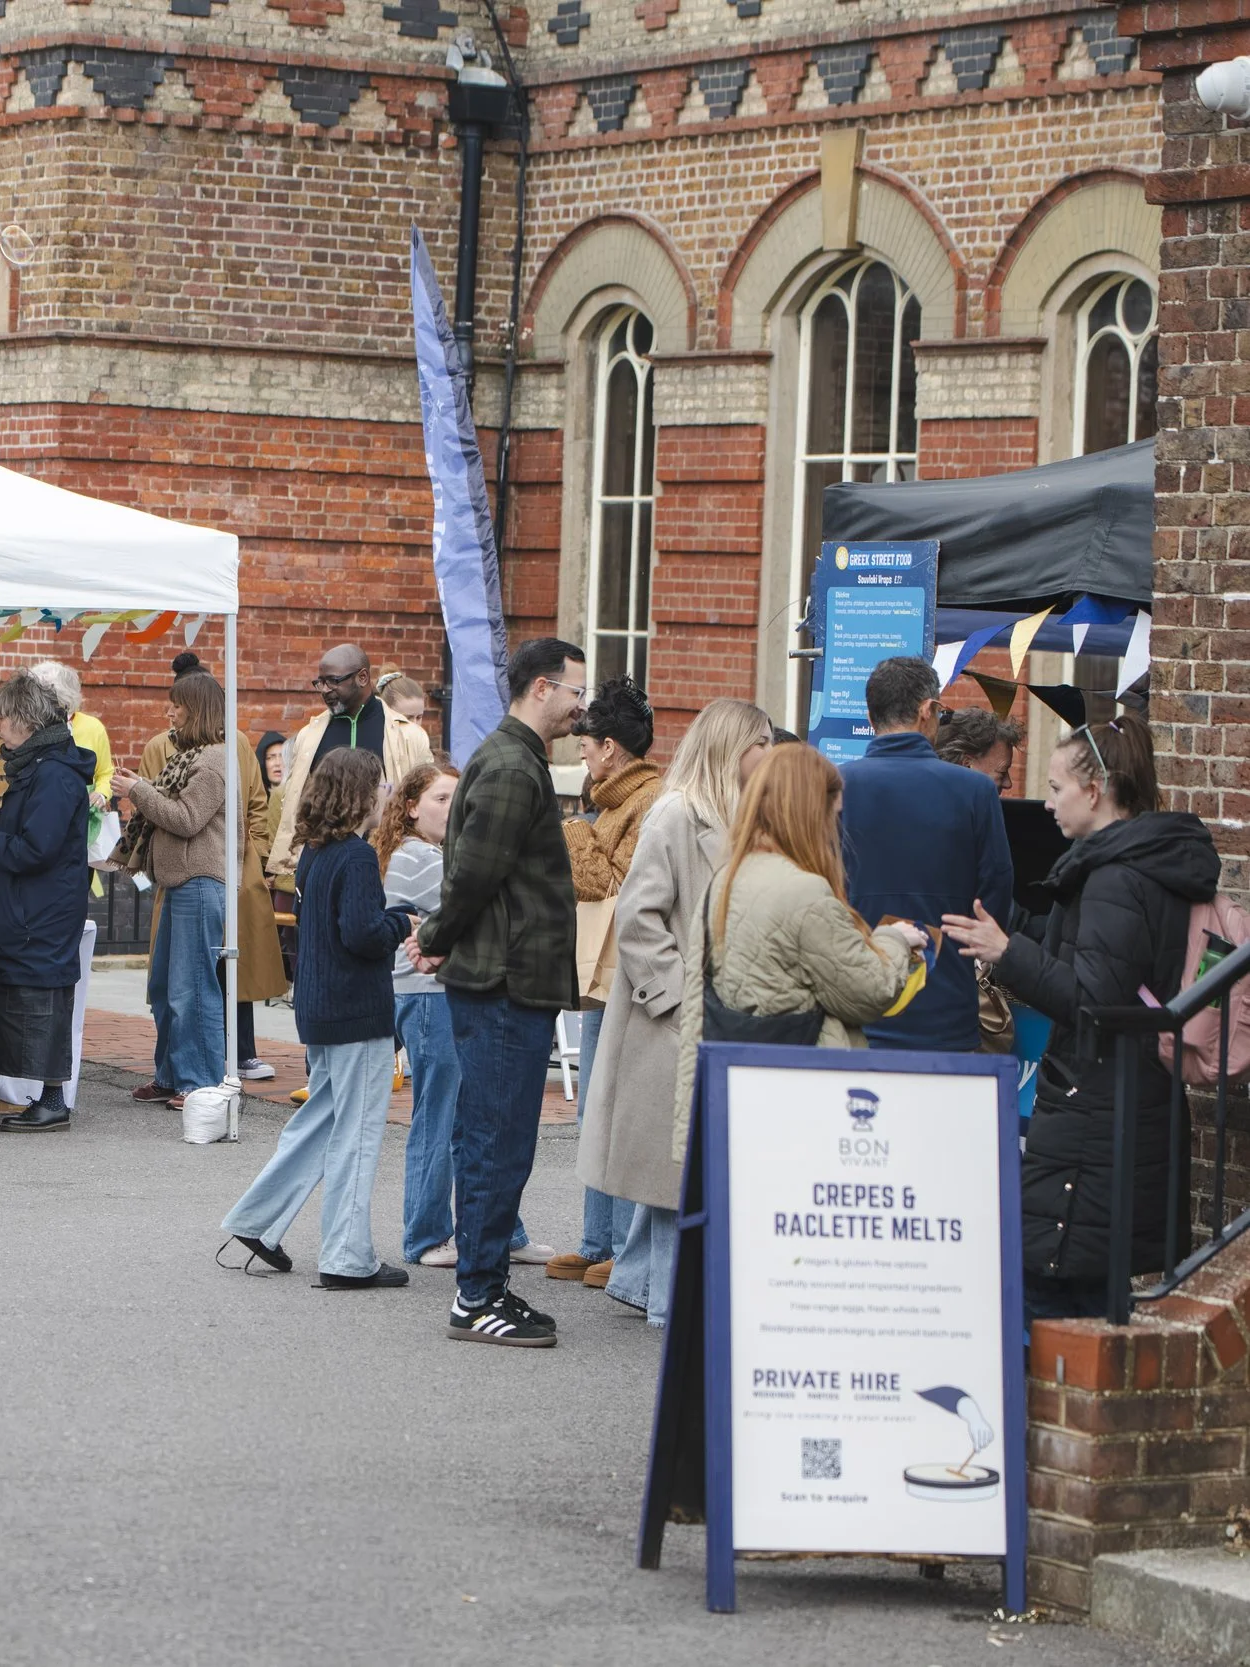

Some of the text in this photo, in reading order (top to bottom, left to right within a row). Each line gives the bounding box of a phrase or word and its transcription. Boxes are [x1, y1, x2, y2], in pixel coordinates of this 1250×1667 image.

[849, 553, 912, 566] GREEK STREET FOOD
[857, 574, 878, 584] Souvlaki
[852, 725, 869, 736] Loaded
[838, 1137, 889, 1156] BON
[813, 1182, 916, 1210] CREPES &
[774, 1212, 963, 1243] RACLETTE MELTS
[752, 1368, 900, 1391] PRIVATE HIRE
[780, 1491, 868, 1505] Scan to enquire
